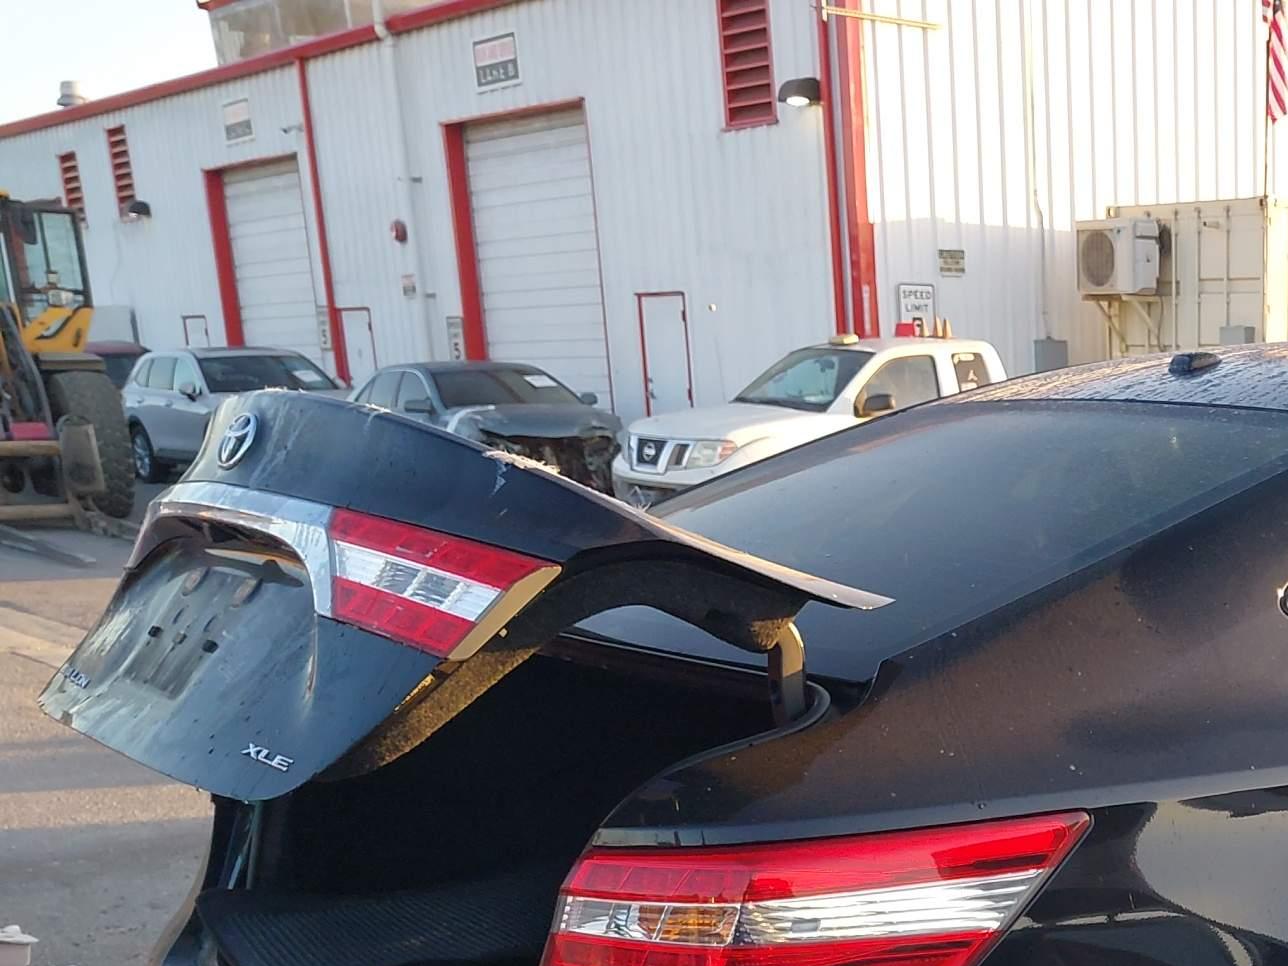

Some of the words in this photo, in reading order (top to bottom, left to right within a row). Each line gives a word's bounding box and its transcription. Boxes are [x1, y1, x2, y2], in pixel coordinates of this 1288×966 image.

[902, 289, 931, 300] SPEED
[905, 303, 929, 313] LIMIT
[240, 743, 294, 772] XLE
